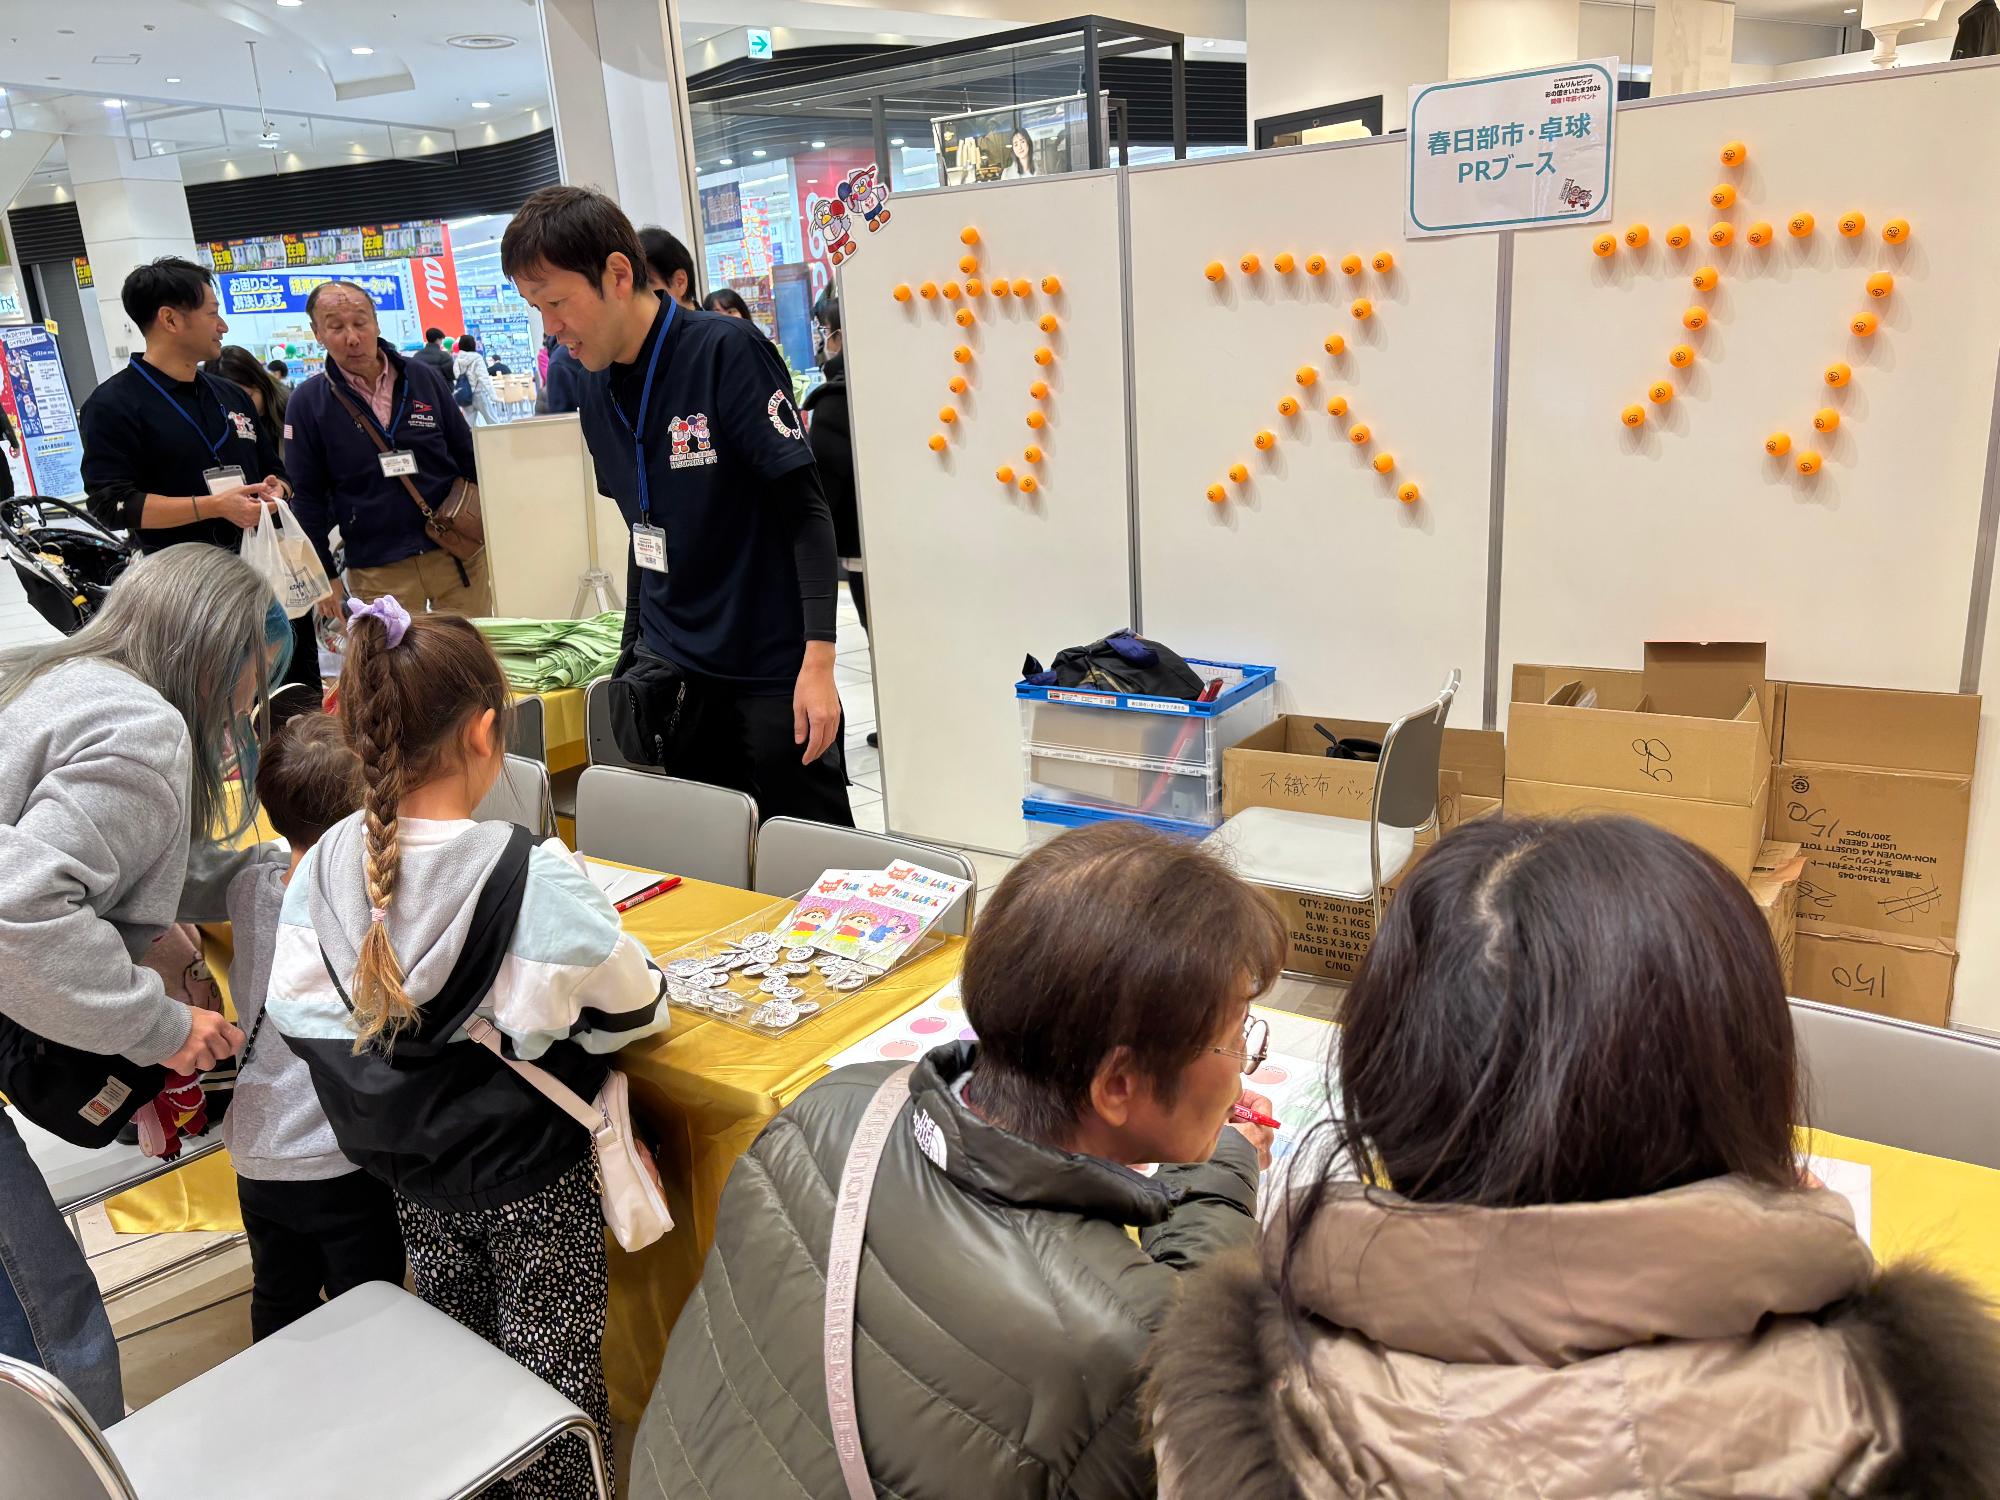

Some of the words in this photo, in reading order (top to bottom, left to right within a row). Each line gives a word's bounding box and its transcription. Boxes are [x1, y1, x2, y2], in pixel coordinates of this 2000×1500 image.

[1553, 78, 1593, 89] ねんりんピック
[1427, 112, 1592, 156] 春日部市・卓球
[1458, 151, 1556, 184] PRブース
[423, 257, 449, 309] au
[1787, 802, 1840, 838] 150
[1838, 837, 1869, 848] GREEN
[1846, 829, 1892, 842] 200/10pcs
[1825, 845, 1859, 855] GUSETT
[1862, 848, 1875, 857] A4
[1871, 840, 1897, 851] LIGHT
[1840, 855, 1893, 867] ライトグリーン
[1876, 849, 1937, 864] NON-WOVEN
[1838, 871, 1892, 884] TR-1340-045
[1298, 897, 1322, 910] QTY:
[1305, 910, 1329, 923] N.W:
[1332, 914, 1347, 925] 5.1
[1350, 918, 1371, 929] KGS
[1305, 922, 1329, 935] G.W:
[1332, 926, 1347, 937] 6.3
[1350, 930, 1371, 941] KGS
[1294, 942, 1324, 956] MADE
[1325, 948, 1336, 958] IN
[1316, 936, 1328, 945] 55
[1330, 937, 1338, 947] X
[1339, 939, 1351, 949] 36
[1353, 941, 1361, 951] X
[1325, 960, 1353, 974] C/NO.
[1831, 963, 1886, 998] 150
